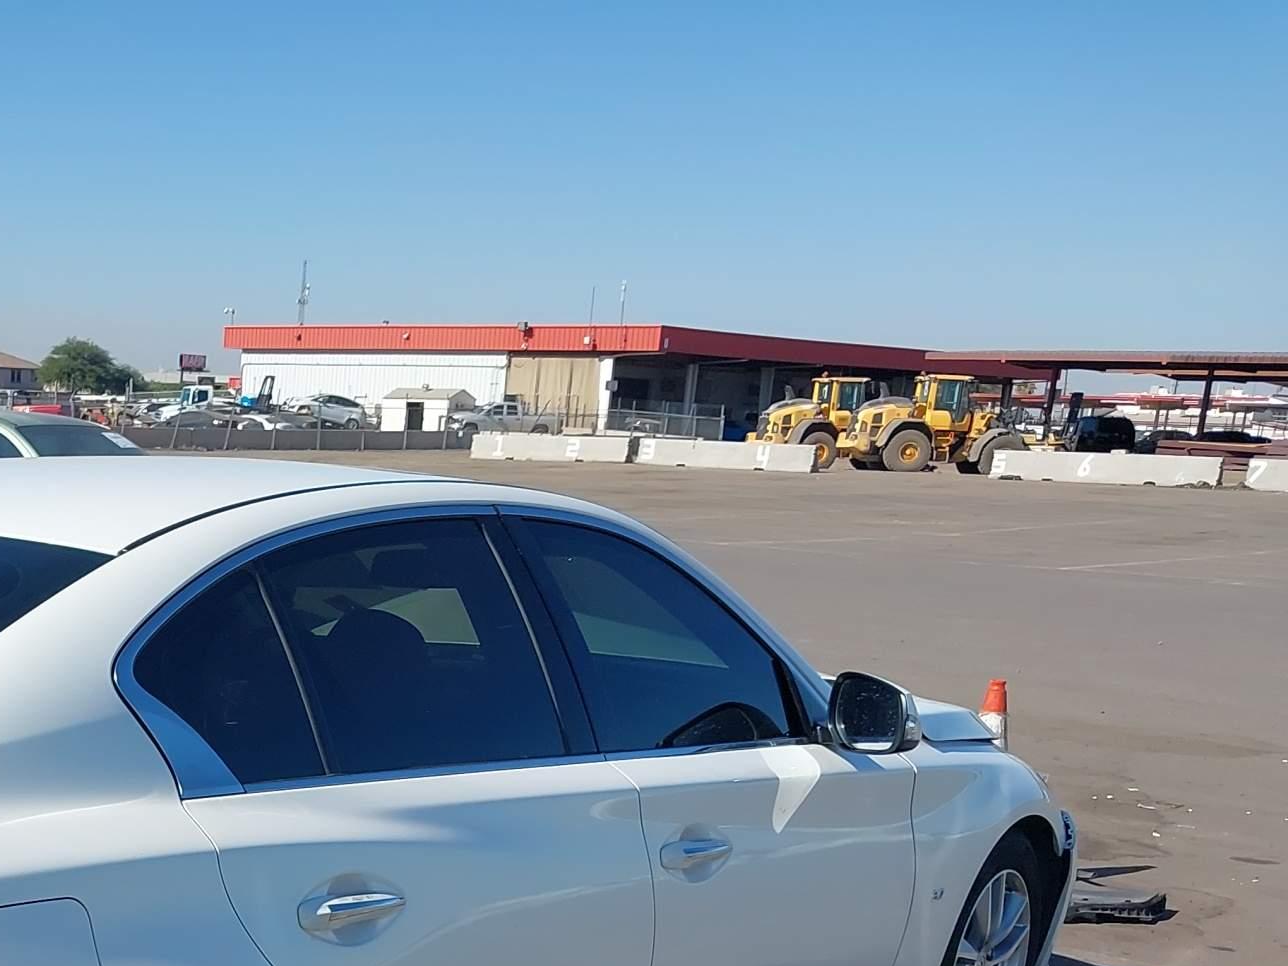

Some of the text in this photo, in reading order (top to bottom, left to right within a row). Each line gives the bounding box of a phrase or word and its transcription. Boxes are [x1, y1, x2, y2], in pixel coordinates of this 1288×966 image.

[492, 436, 505, 457] 1
[565, 439, 581, 457] 2
[640, 439, 656, 460] 3
[756, 444, 771, 469] 4
[991, 454, 1007, 474] 5
[1077, 455, 1095, 477] 6
[1247, 461, 1268, 484] 7
